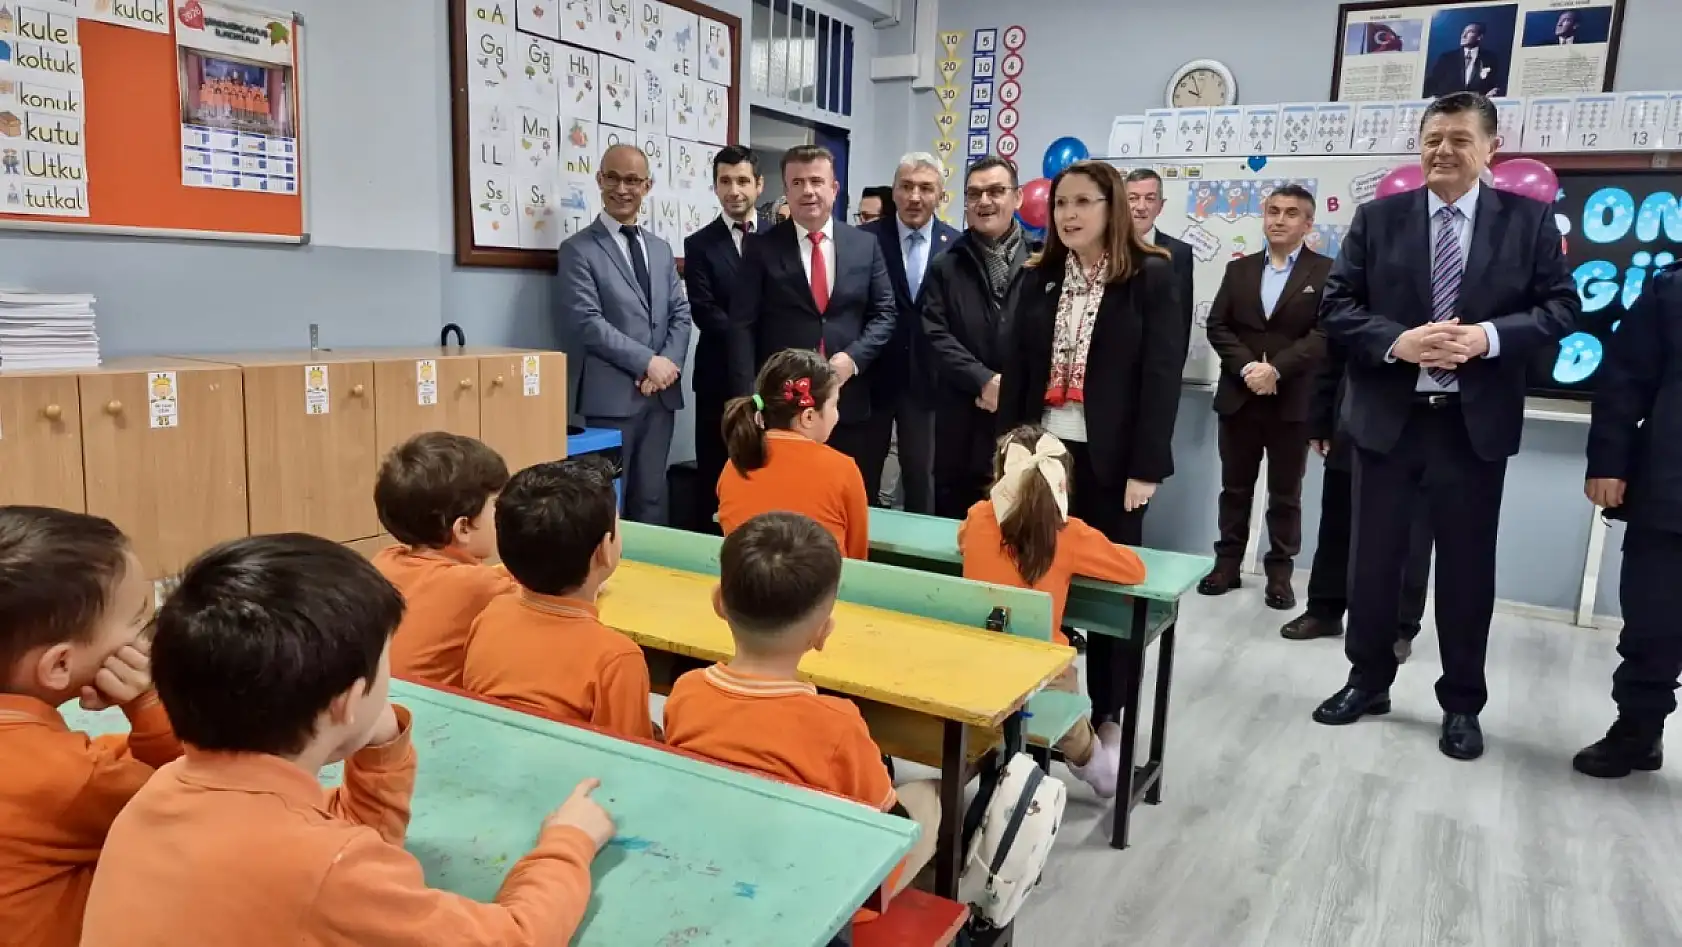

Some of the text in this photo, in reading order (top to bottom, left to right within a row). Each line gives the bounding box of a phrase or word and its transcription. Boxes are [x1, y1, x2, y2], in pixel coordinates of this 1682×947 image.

[114, 0, 164, 25] kulak
[491, 4, 505, 25] A
[643, 3, 660, 24] Dd
[17, 6, 69, 44] kule
[946, 35, 958, 45] 10
[982, 36, 990, 47] 5
[1010, 34, 1018, 44] 2
[480, 33, 504, 66] Gg
[528, 38, 551, 74] Ğğ
[16, 42, 76, 74] koltuk
[569, 53, 589, 77] Hh
[683, 58, 690, 76] E
[943, 62, 957, 71] 20
[978, 63, 991, 73] 10
[1008, 61, 1015, 71] 4
[20, 81, 78, 112] konuk
[942, 89, 955, 99] 30
[976, 88, 988, 98] 15
[1006, 88, 1013, 97] 6
[523, 114, 549, 138] Mm
[940, 115, 953, 125] 40
[974, 115, 987, 124] 20
[1004, 115, 1011, 124] 8
[25, 110, 79, 146] kutu
[972, 140, 983, 149] 25
[1367, 137, 1378, 150] 7
[1406, 137, 1415, 150] 8
[1540, 134, 1552, 147] 11
[1581, 133, 1599, 147] 12
[1632, 131, 1649, 146] 13
[939, 142, 951, 151] 50
[1002, 140, 1014, 151] 10
[1185, 140, 1194, 153] 2
[1219, 140, 1227, 153] 3
[1253, 140, 1263, 152] 4
[1290, 140, 1299, 153] 5
[1325, 140, 1334, 153] 6
[26, 150, 82, 179] Utku
[578, 155, 590, 174] N
[486, 180, 503, 200] Ss
[24, 184, 83, 210] tutkal
[1326, 196, 1340, 213] B
